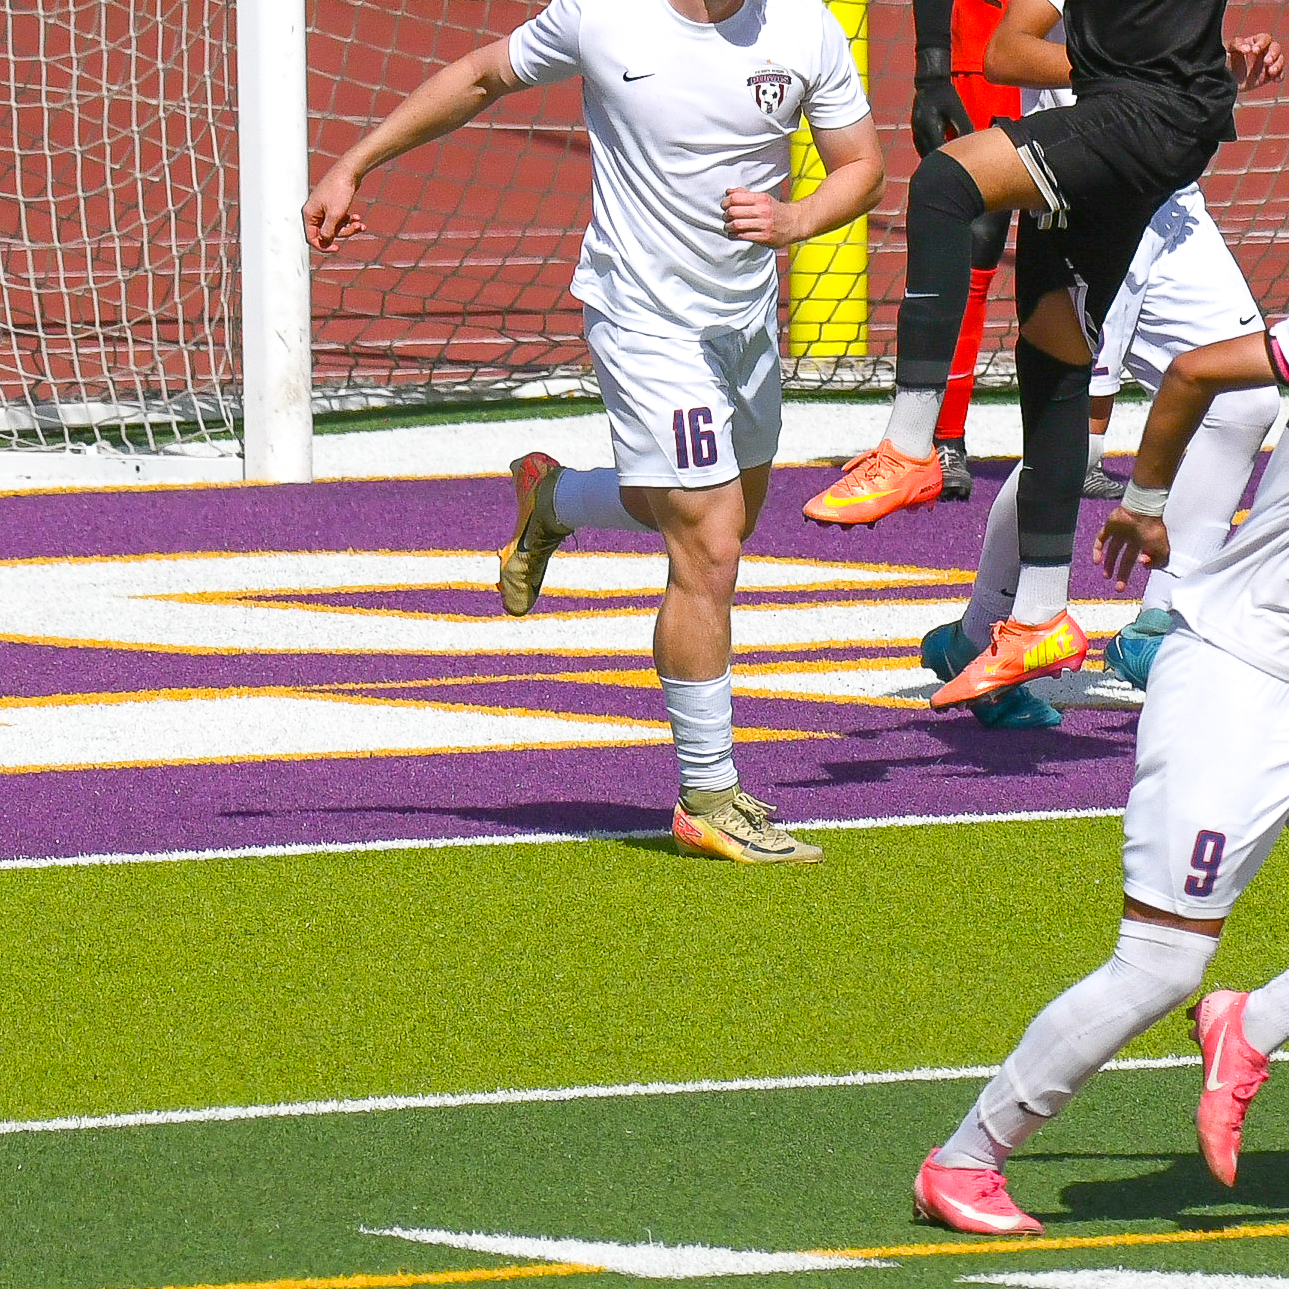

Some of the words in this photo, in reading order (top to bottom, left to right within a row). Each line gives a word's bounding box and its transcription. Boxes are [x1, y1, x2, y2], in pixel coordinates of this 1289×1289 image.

[673, 407, 718, 469] 16
[1023, 623, 1077, 673] NIKE
[1184, 829, 1226, 897] 9
